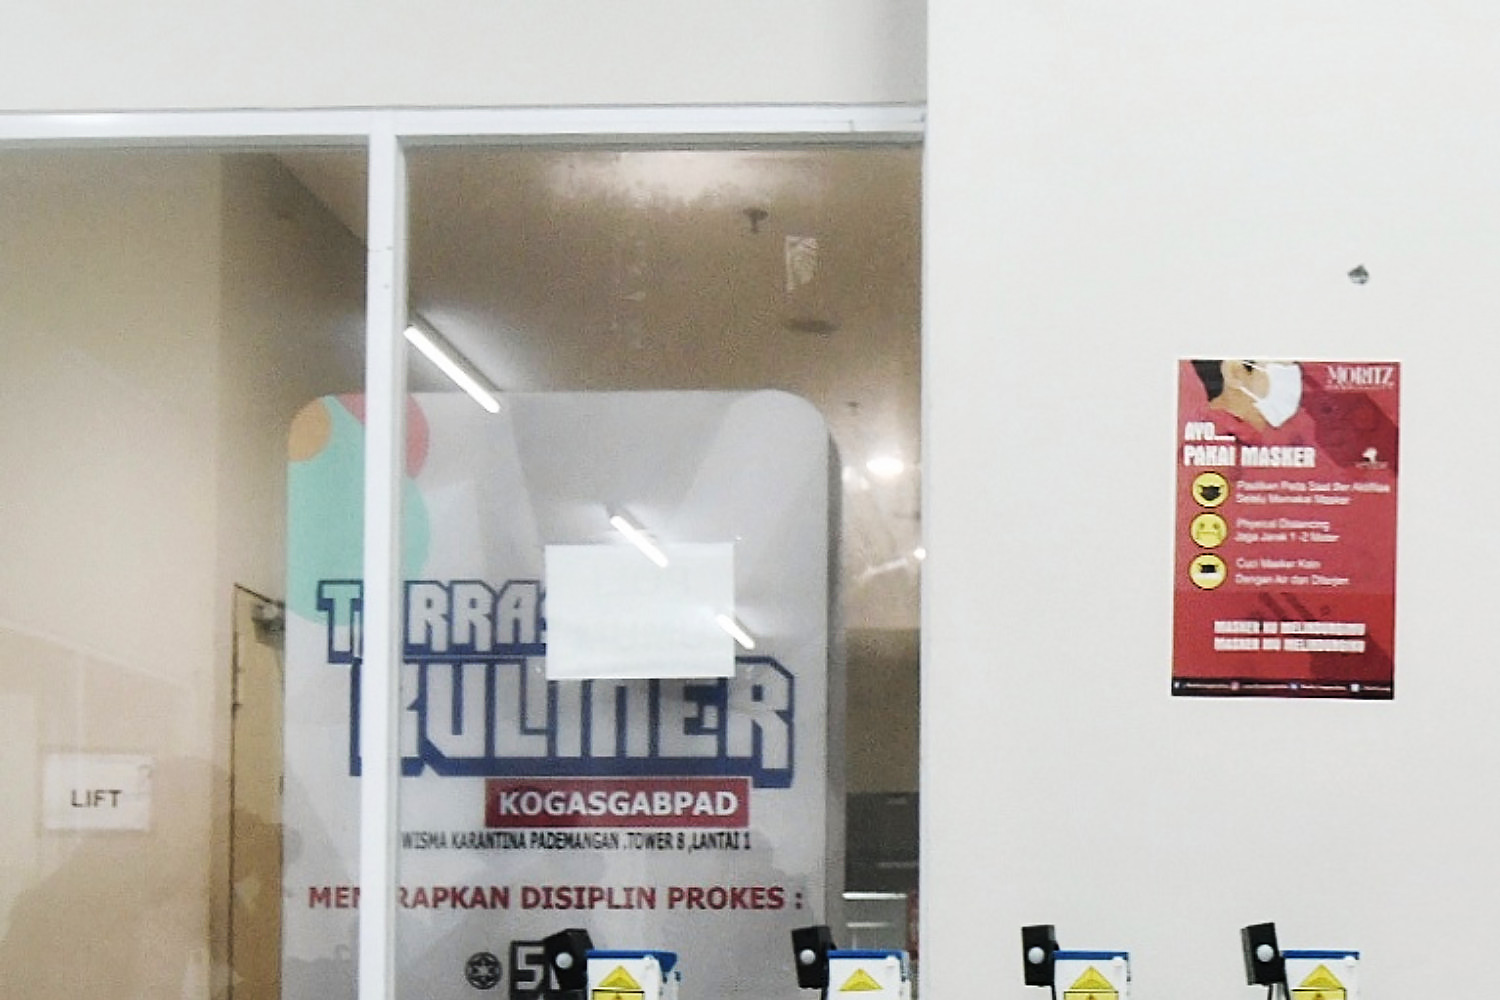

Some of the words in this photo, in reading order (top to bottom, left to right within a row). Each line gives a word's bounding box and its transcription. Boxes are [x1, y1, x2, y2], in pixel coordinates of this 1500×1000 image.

[1184, 445, 1236, 466] PAKAI
[1241, 446, 1316, 468] MASKER
[317, 579, 546, 664] TRRA
[70, 789, 122, 808] LIFT
[501, 791, 739, 816] KOGASGABPAD
[451, 831, 526, 849] KARANTINA
[530, 831, 619, 850] PADEMANGAN
[308, 886, 510, 909] MERAPKAN
[520, 886, 656, 909] DISIPLIN
[667, 886, 785, 909] PROKES
